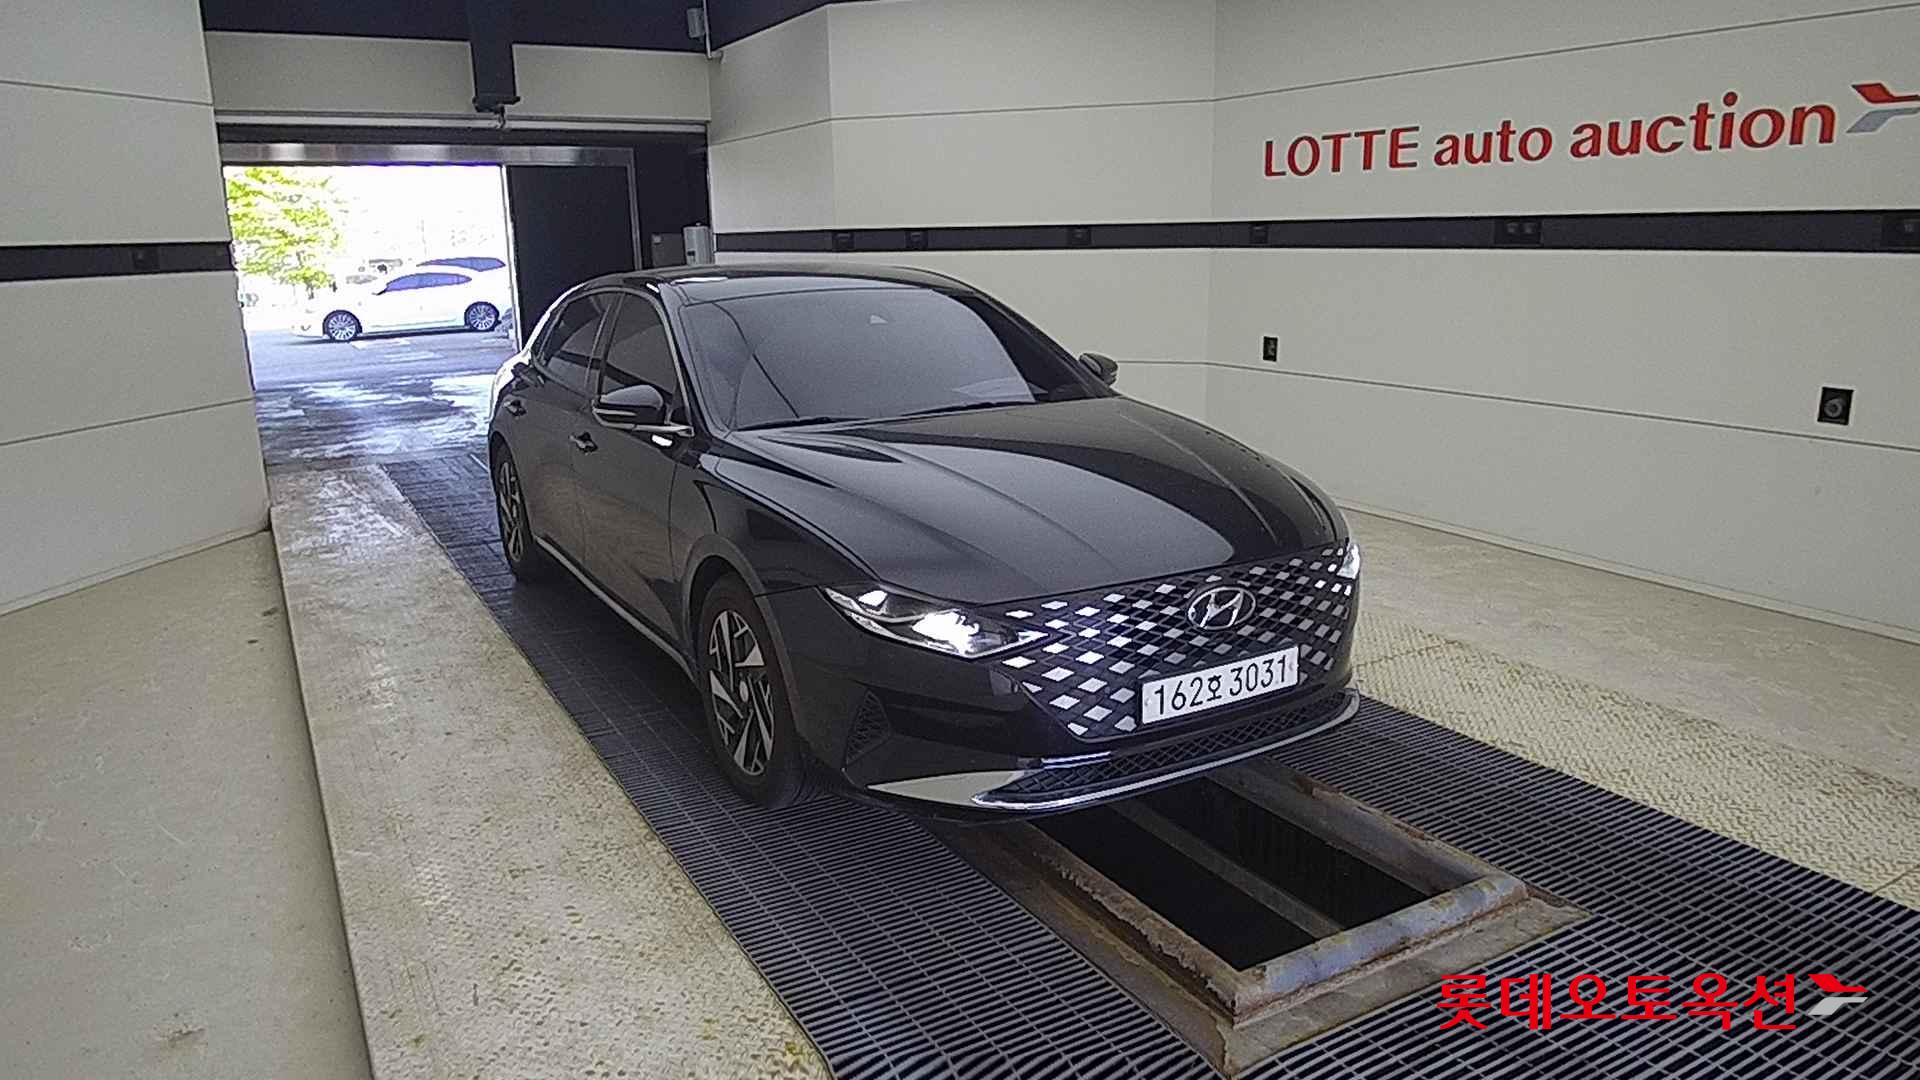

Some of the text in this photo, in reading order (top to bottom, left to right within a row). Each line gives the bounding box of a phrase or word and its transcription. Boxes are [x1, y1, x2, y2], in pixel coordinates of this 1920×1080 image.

[1263, 91, 1837, 178] LOTTE auto auction
